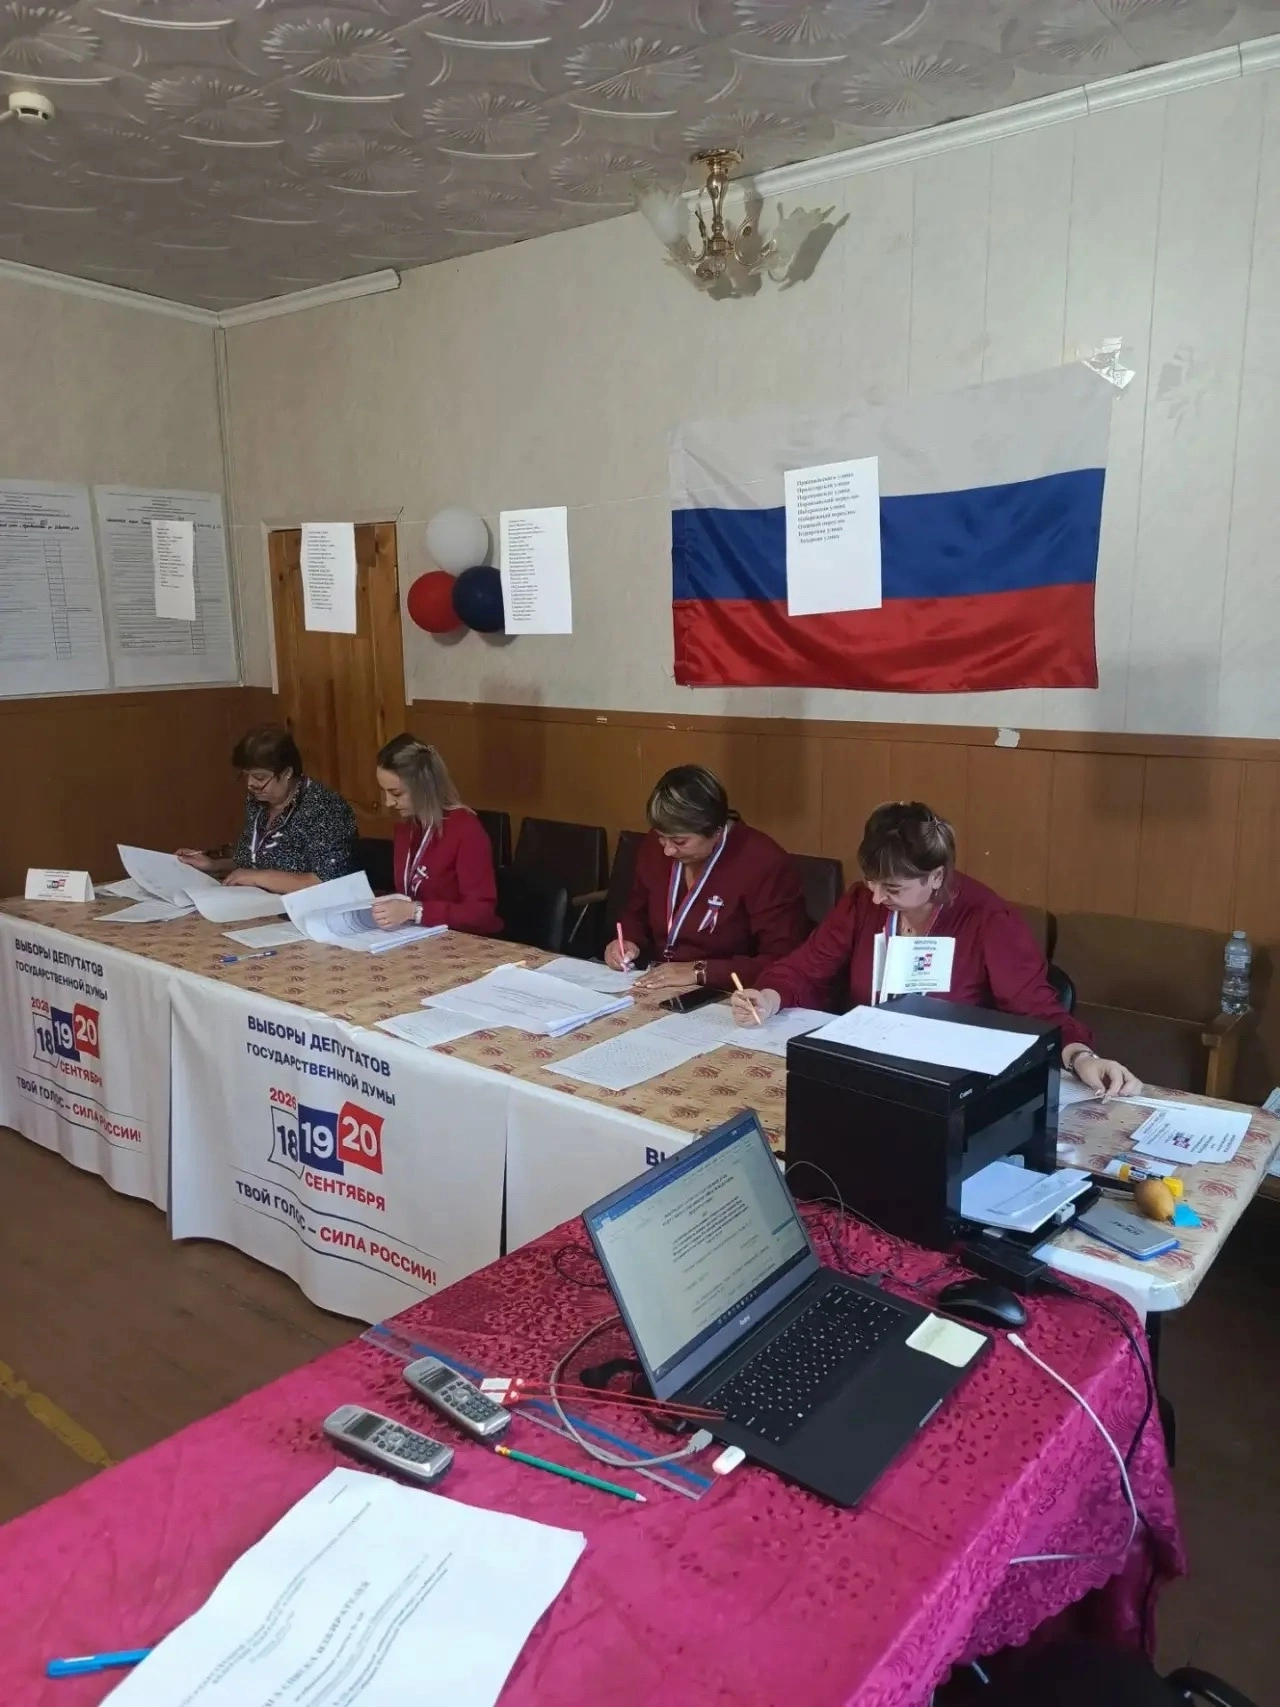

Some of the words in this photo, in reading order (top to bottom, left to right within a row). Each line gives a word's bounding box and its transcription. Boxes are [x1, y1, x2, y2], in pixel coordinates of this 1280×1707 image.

[15, 938, 51, 961] ВЫБОРЫ
[53, 949, 104, 977] ДЕПУТАТОВ
[15, 960, 85, 992] ГОСУДАРСТВЕННОЙ
[86, 983, 108, 1001] ДУМЫ
[37, 1026, 55, 1056] 18
[54, 1020, 73, 1050] 19
[75, 1014, 97, 1046] 20
[247, 1015, 306, 1047] ВЫБОРЫ
[309, 1033, 391, 1077] ДЕПУТАТОВ
[246, 1042, 359, 1090] ГОСУДАРСТВЕННОЙ
[361, 1082, 396, 1107] ДУМЫ
[16, 1075, 38, 1095] ТВОЙ
[39, 1085, 65, 1109] ГОЛОС
[72, 1102, 99, 1123] СИЛА
[276, 1125, 299, 1163] 18
[301, 1121, 335, 1159] 19
[341, 1115, 379, 1158] 20
[304, 1171, 386, 1212] СЕНТЯБРЯ
[235, 1180, 271, 1205] ТВОЙ
[274, 1195, 306, 1232] ГОЛОС
[319, 1226, 367, 1254] СИЛА
[370, 1242, 437, 1287] РОССИИ!
